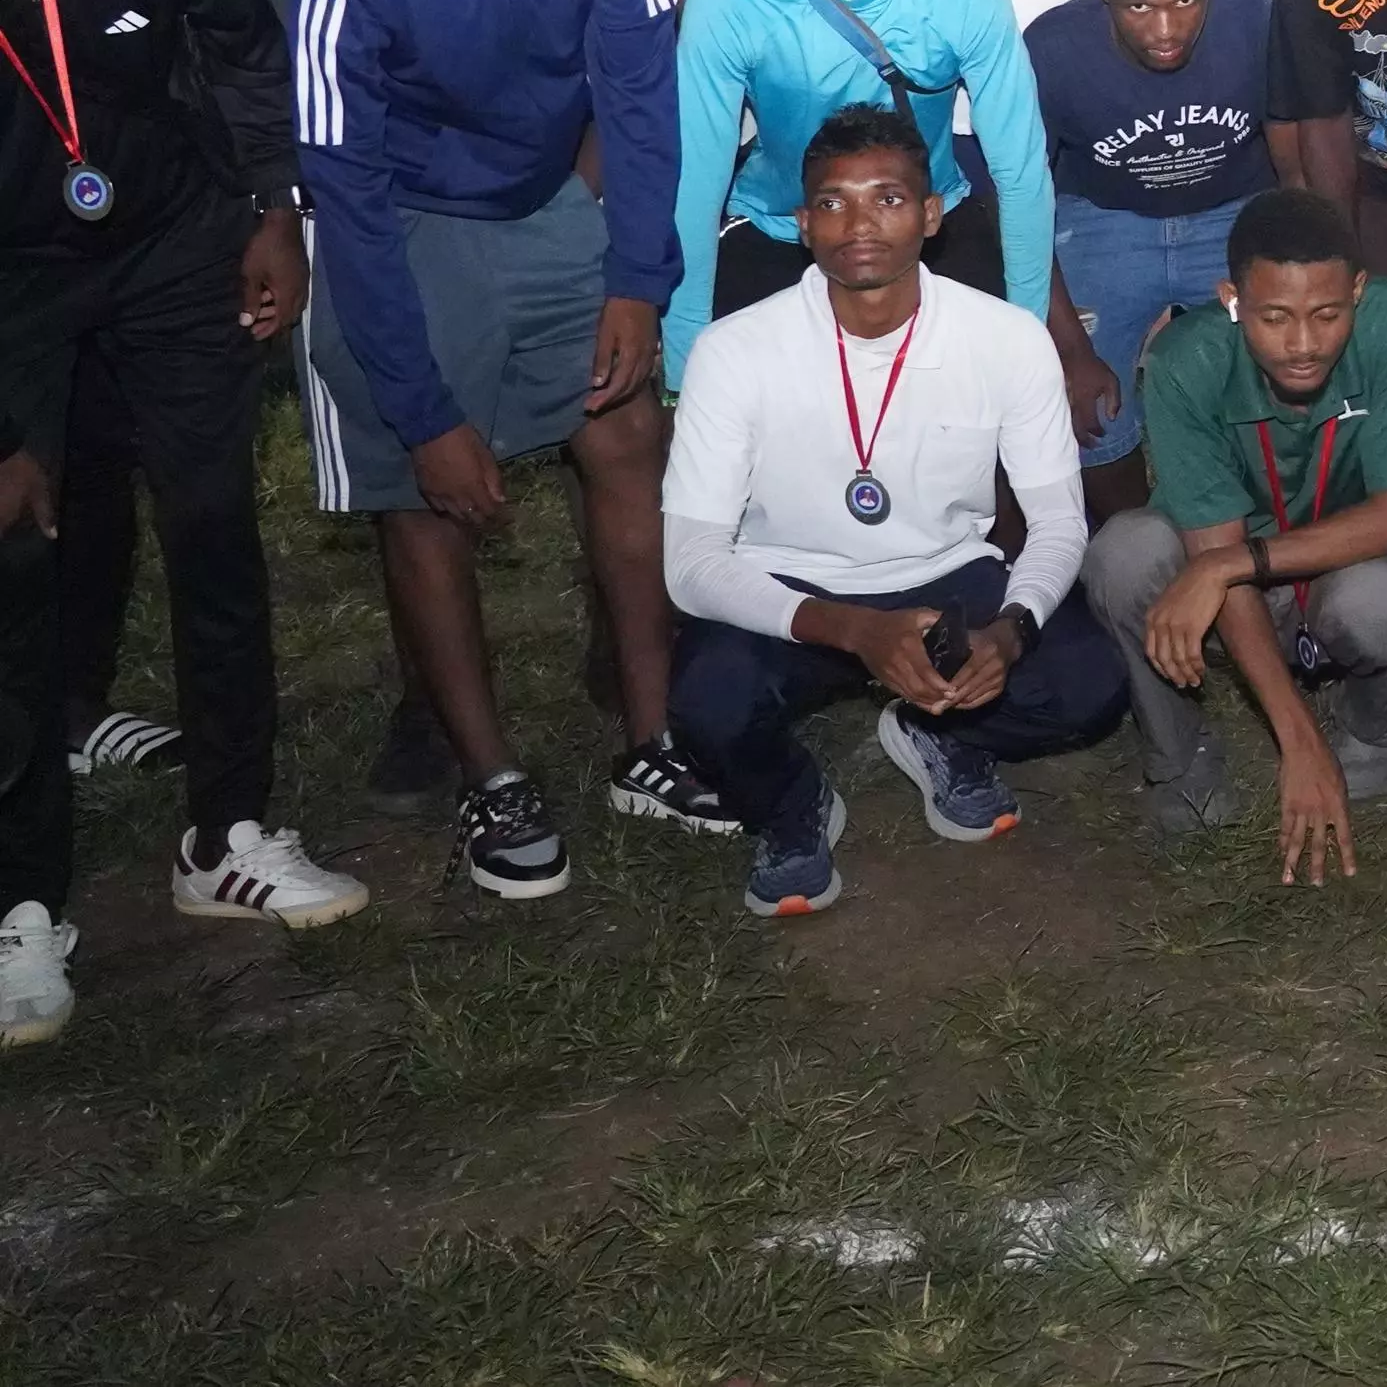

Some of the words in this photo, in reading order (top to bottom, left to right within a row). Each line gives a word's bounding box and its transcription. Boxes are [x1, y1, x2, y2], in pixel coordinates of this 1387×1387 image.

[1092, 109, 1165, 159] RELAY
[1173, 105, 1250, 132] JEANS
[1093, 153, 1122, 168] SINCE
